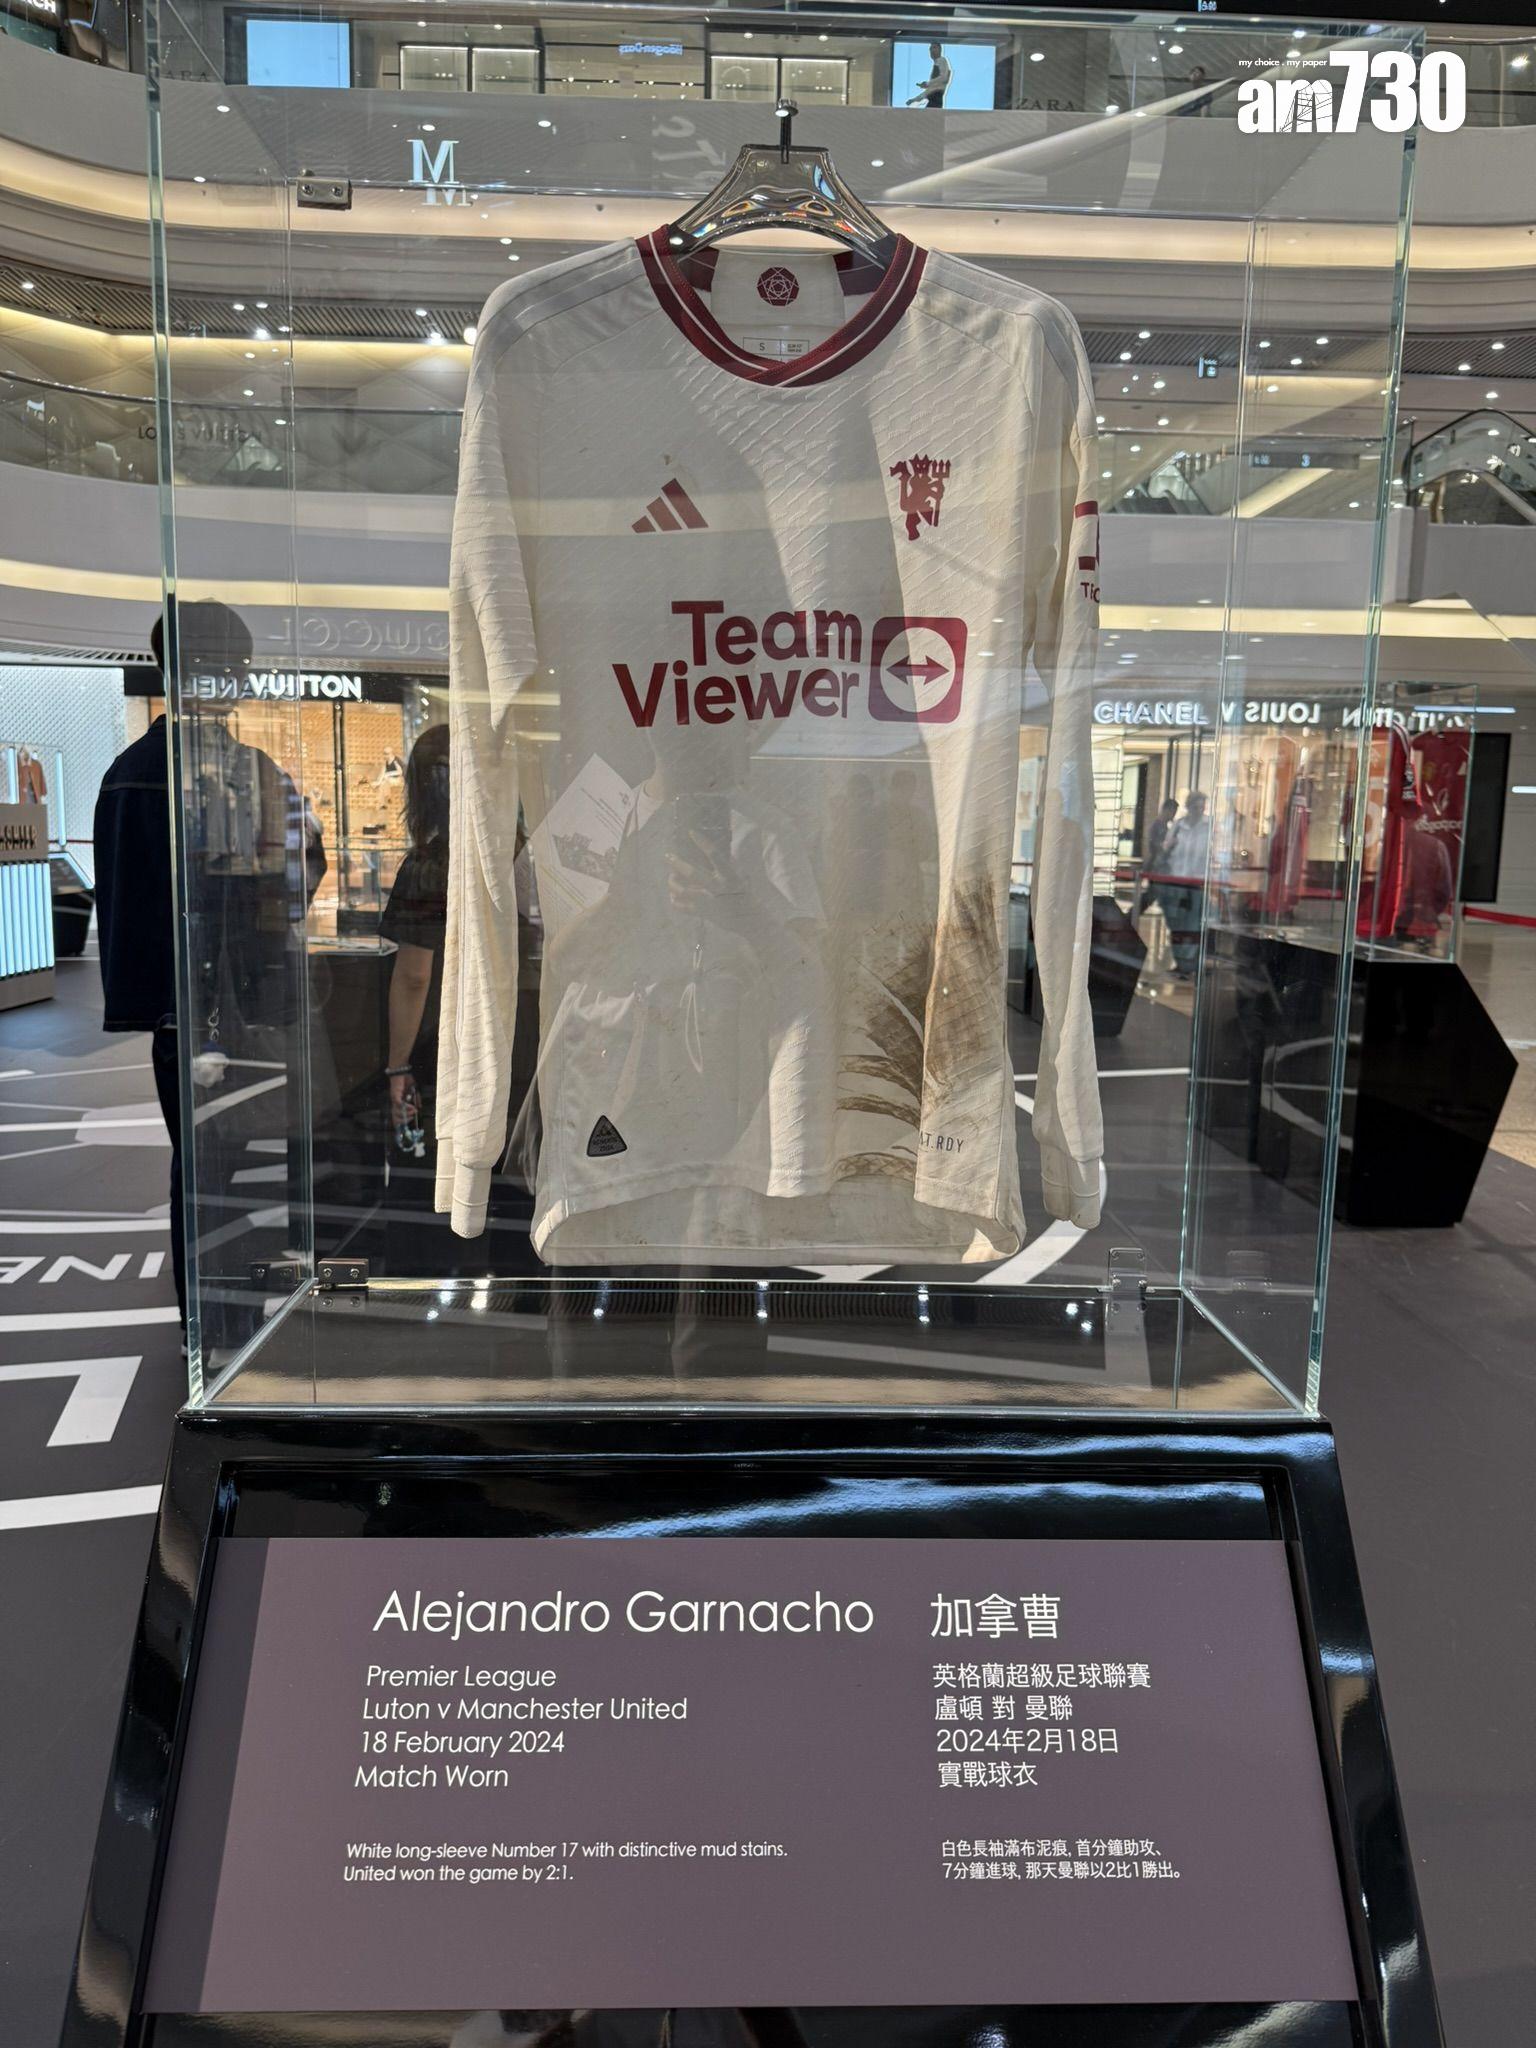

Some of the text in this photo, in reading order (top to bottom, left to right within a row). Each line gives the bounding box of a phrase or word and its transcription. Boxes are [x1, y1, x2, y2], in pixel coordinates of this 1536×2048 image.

[671, 600, 863, 668] Team
[248, 672, 362, 699] VUITTON
[611, 659, 861, 728] Viewer
[1093, 701, 1209, 725] CHANEL
[372, 1589, 875, 1641] Alejandro Garnacho
[930, 1592, 1061, 1639] 加拿曹
[366, 1664, 557, 1692] Premier League
[932, 1662, 1152, 1689] 英格蘭超級足球聯賽
[362, 1697, 688, 1720] Luton v Manchester United
[934, 1694, 1073, 1721] 盧頓 對 曼聯
[361, 1730, 565, 1758] 18 February 2024
[936, 1727, 1119, 1754] 2024年2月18日
[354, 1764, 509, 1788] Match Worn
[938, 1760, 1039, 1788] 實戰球衣
[346, 1840, 789, 1862] White long-sleeve Number 17 with distinctive mud stains.
[343, 1864, 574, 1885] United won the game by 2:1.
